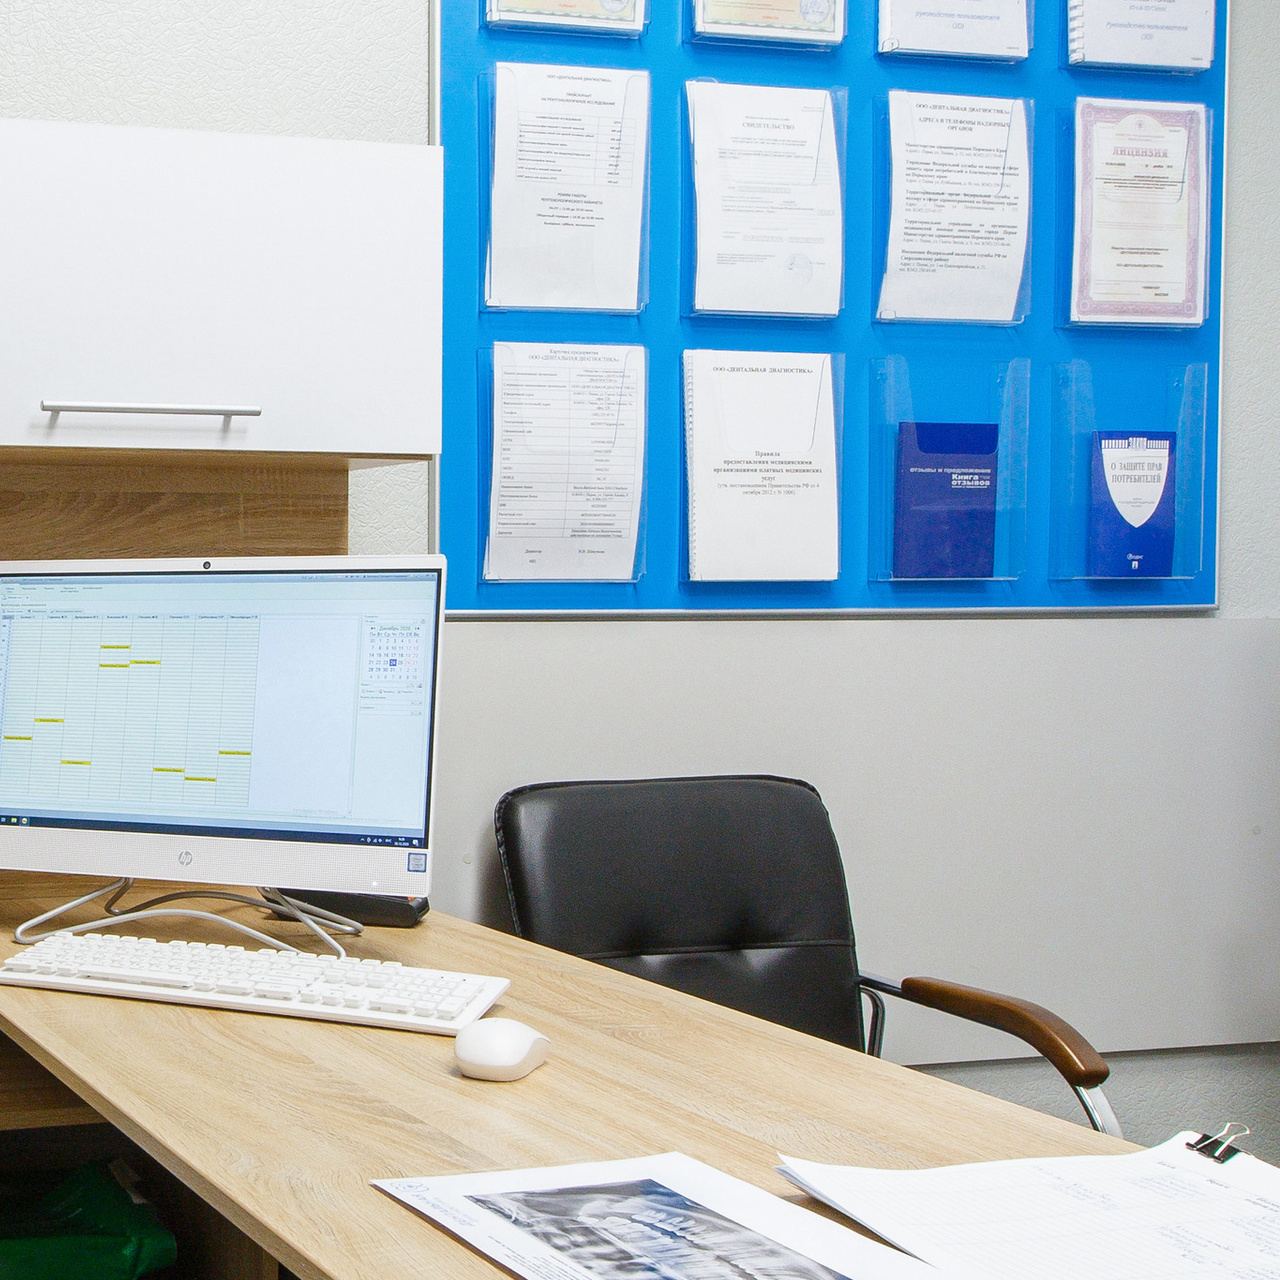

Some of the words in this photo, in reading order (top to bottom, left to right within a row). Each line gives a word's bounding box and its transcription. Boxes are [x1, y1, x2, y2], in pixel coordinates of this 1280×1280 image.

[1112, 146, 1168, 158] ЛИЦЕНЗИЯ
[1119, 463, 1146, 471] ЗАЩИТЕ
[1148, 463, 1162, 471] ПРАВ
[1112, 474, 1161, 483] ПОТРЕБИТЕЛЕЙ
[178, 850, 193, 867] hp
